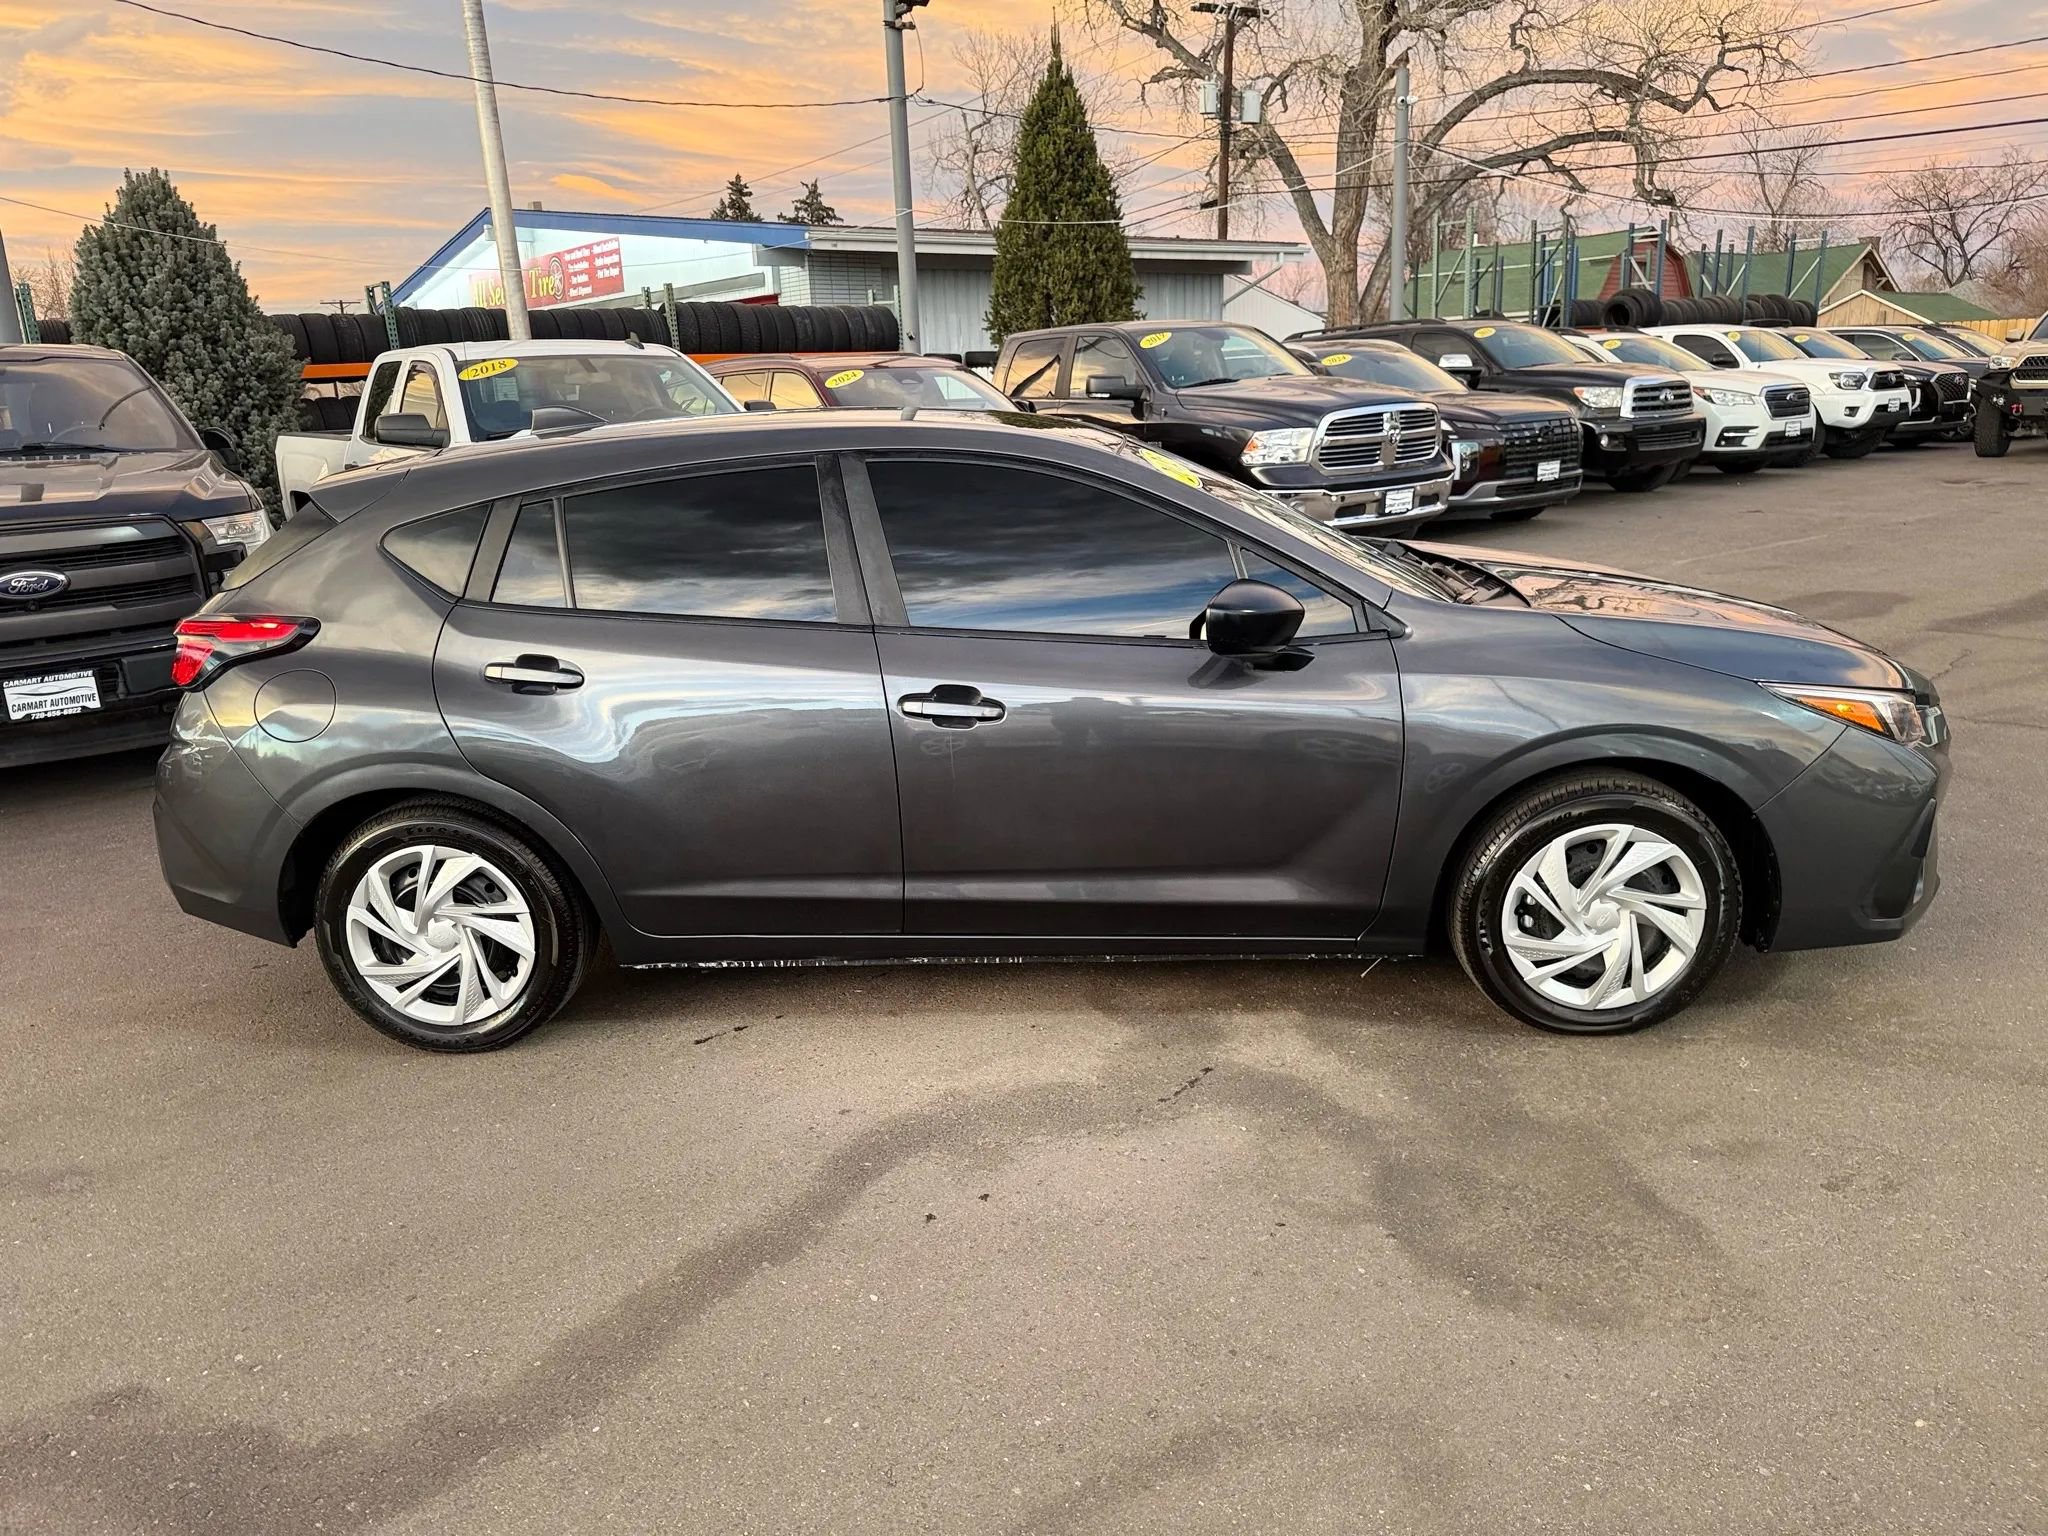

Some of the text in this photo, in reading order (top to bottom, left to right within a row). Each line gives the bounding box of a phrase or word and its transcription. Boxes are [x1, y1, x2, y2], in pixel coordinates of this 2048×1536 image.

[529, 266, 556, 299] Tire
[470, 360, 507, 378] 2018
[832, 371, 857, 386] 2024
[8, 576, 49, 594] Ford
[3, 670, 94, 688] CARMART AUTOMOTIVE
[11, 693, 97, 713] CARMART AUTOMOTIVE
